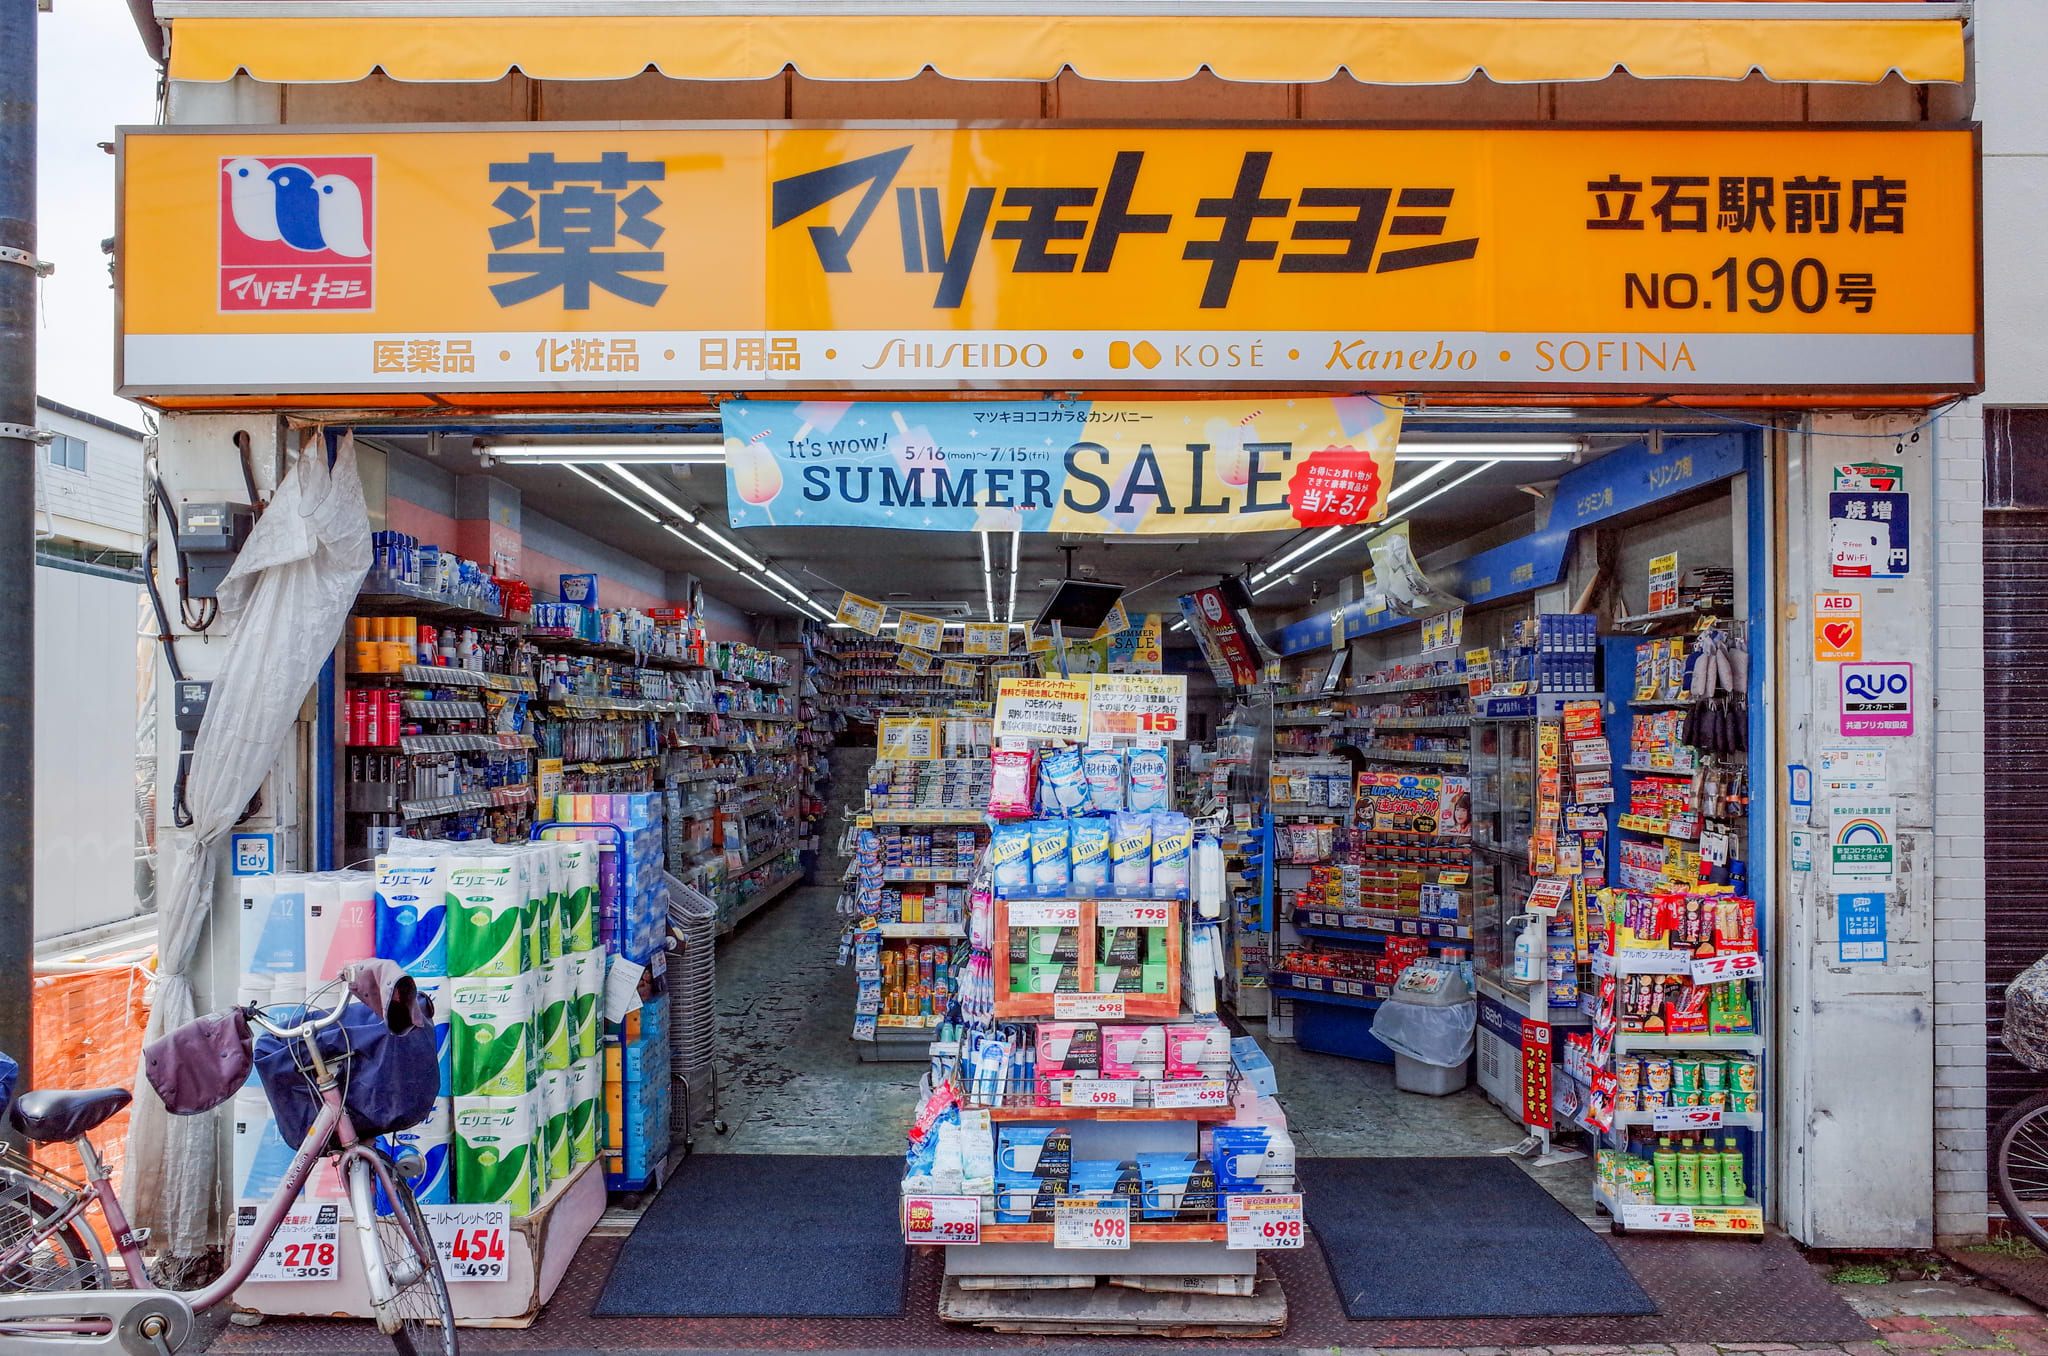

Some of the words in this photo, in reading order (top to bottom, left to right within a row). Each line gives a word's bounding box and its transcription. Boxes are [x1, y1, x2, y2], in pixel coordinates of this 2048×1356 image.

[1586, 173, 1907, 235] 立石駅前店
[487, 151, 668, 311] 薬
[772, 144, 1480, 309] マツモトキヨシ
[227, 273, 367, 307] マツモトキヨシ
[372, 339, 475, 374] 医薬品
[535, 338, 640, 373] 化粧品
[698, 338, 801, 372] 日用品
[861, 338, 1048, 371] SHISEIDO
[1174, 338, 1264, 368] KOSÉ
[1325, 339, 1478, 371] Kanebo
[1535, 340, 1696, 372] SOFINA
[973, 410, 1153, 423] マツキヨココカラ&カンパニー
[788, 438, 822, 459] It's
[803, 465, 1053, 508] SUMMER
[1063, 442, 1293, 514] SALE
[1309, 466, 1372, 481] お得にお買い物が
[1853, 466, 1895, 476] フジカラー
[1307, 477, 1368, 492] できて豪華賞品が
[1889, 548, 1907, 566] 円
[1824, 597, 1852, 608] AED
[1114, 637, 1155, 648] SALE
[1845, 673, 1908, 700] QUO
[1084, 762, 1118, 776] 超快適
[1131, 762, 1164, 776] 超快適
[998, 839, 1022, 856] Fitty
[1037, 838, 1062, 855] Fitty
[1077, 841, 1100, 856] Fitty
[1119, 837, 1144, 853] Fitty
[1158, 838, 1183, 853] Fitty
[240, 854, 266, 868] Edy
[379, 875, 433, 887] エリエール
[453, 876, 509, 888] エリエール
[281, 899, 294, 917] 12
[351, 906, 364, 924] 12
[1044, 908, 1077, 919] 798
[1134, 908, 1166, 919] 798
[1706, 956, 1757, 973] 78
[456, 991, 511, 1005] エリエール
[1098, 1004, 1123, 1012] 698
[1526, 1046, 1537, 1120] つかえます。
[1537, 1048, 1549, 1123] たまります。
[1092, 1092, 1117, 1103] 698
[1200, 1090, 1225, 1100] 698
[460, 1114, 515, 1128] エリエール
[1688, 1111, 1720, 1122] 91
[911, 1207, 930, 1219] 当店の
[1658, 1212, 1690, 1223] 73
[909, 1219, 932, 1229] オススメ
[943, 1222, 975, 1234] 298
[1093, 1218, 1125, 1237] 698
[1263, 1221, 1301, 1237] 698
[1729, 1218, 1748, 1229] 70
[437, 1241, 452, 1249] 本体
[452, 1228, 505, 1262] 454
[1274, 1238, 1298, 1246] 767
[283, 1243, 335, 1267] 278
